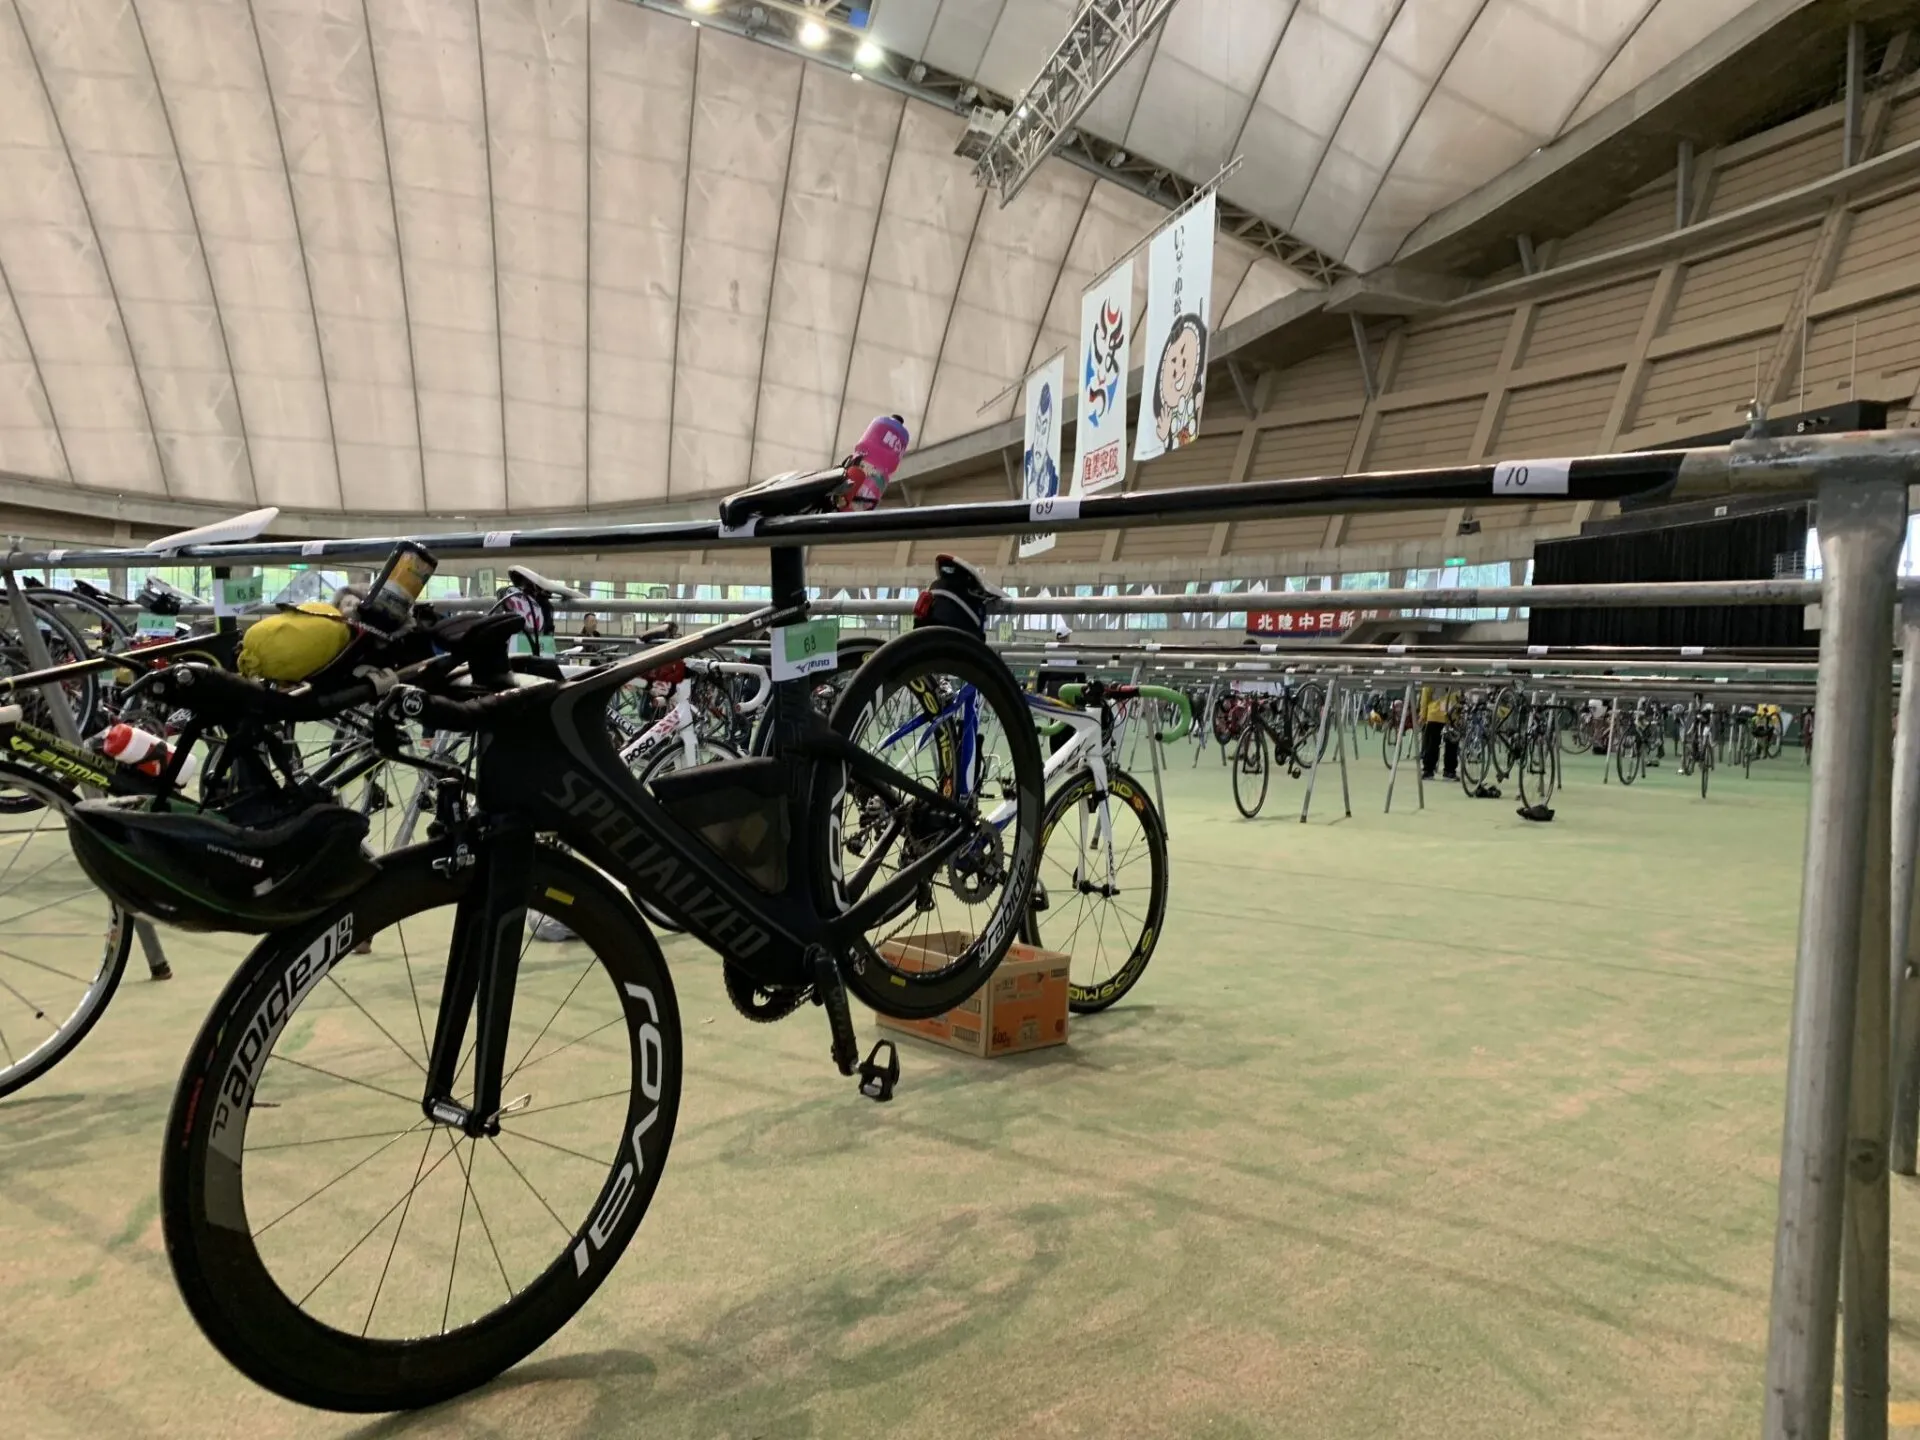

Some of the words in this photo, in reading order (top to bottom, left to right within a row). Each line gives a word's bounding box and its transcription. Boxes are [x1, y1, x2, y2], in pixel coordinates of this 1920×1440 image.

[1036, 501, 1054, 515] 69
[543, 769, 771, 959] SPECIALIZED
[223, 932, 332, 1109] rapide
[573, 981, 663, 1278] roval
